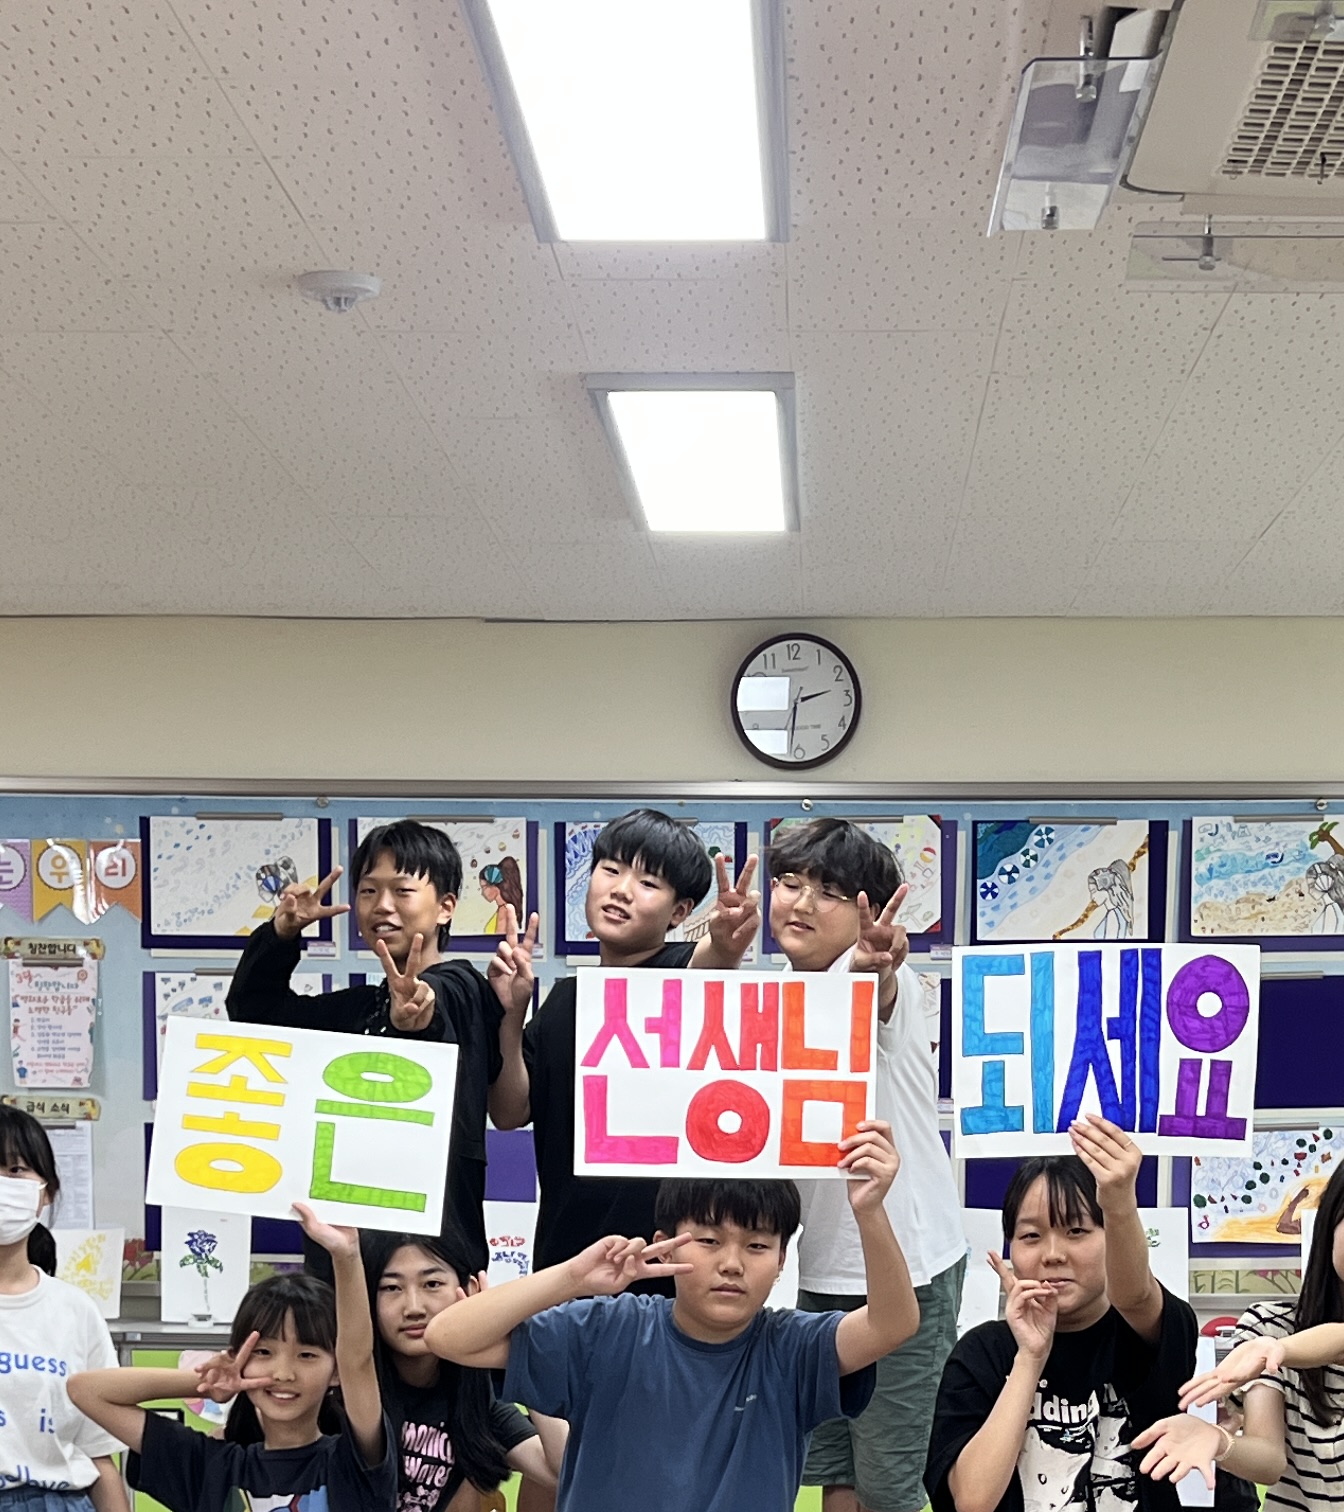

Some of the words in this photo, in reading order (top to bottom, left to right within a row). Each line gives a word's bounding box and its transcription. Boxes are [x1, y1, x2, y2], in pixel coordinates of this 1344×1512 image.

[786, 643, 801, 661] 12
[763, 653, 776, 669] 11
[833, 665, 844, 682] 2
[843, 690, 853, 707] 3
[838, 715, 847, 731] 4
[821, 734, 830, 751] 5
[794, 744, 806, 760] 6
[50, 853, 127, 885] 우리
[28, 942, 77, 955] 칭찬합니다
[960, 948, 1250, 1141] 되세요
[579, 977, 875, 1168] 선생님
[26, 1102, 46, 1114] 급식
[50, 1102, 71, 1115] 소식
[174, 1032, 435, 1213] 좋은
